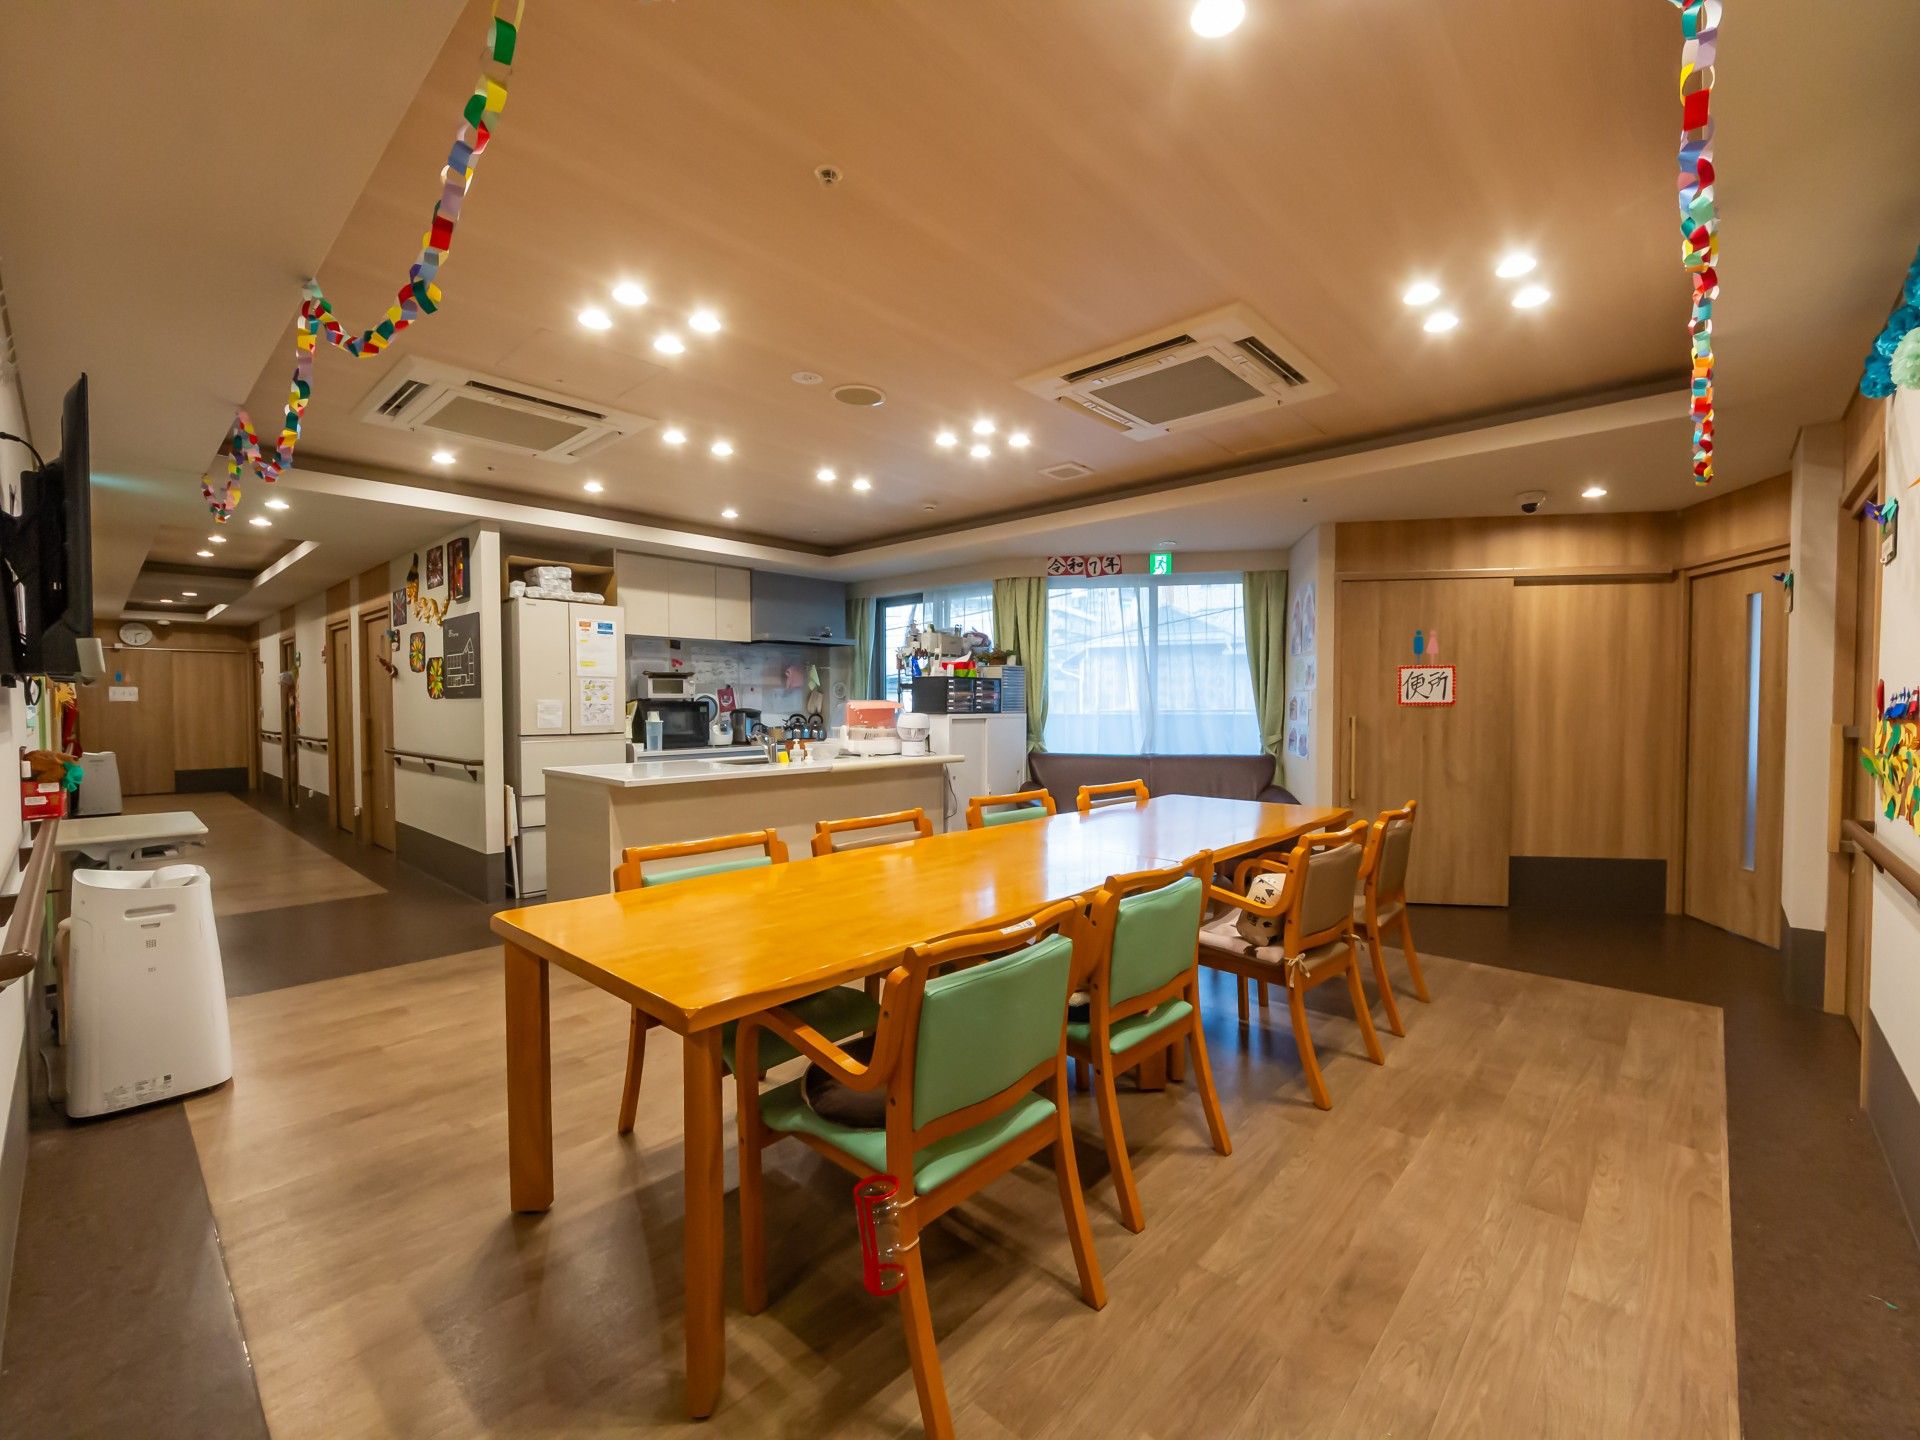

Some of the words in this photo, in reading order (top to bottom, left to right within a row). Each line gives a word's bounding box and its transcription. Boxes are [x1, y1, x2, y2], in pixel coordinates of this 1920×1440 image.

[1047, 556, 1119, 575] 令和7年
[1402, 671, 1449, 701] 便所
